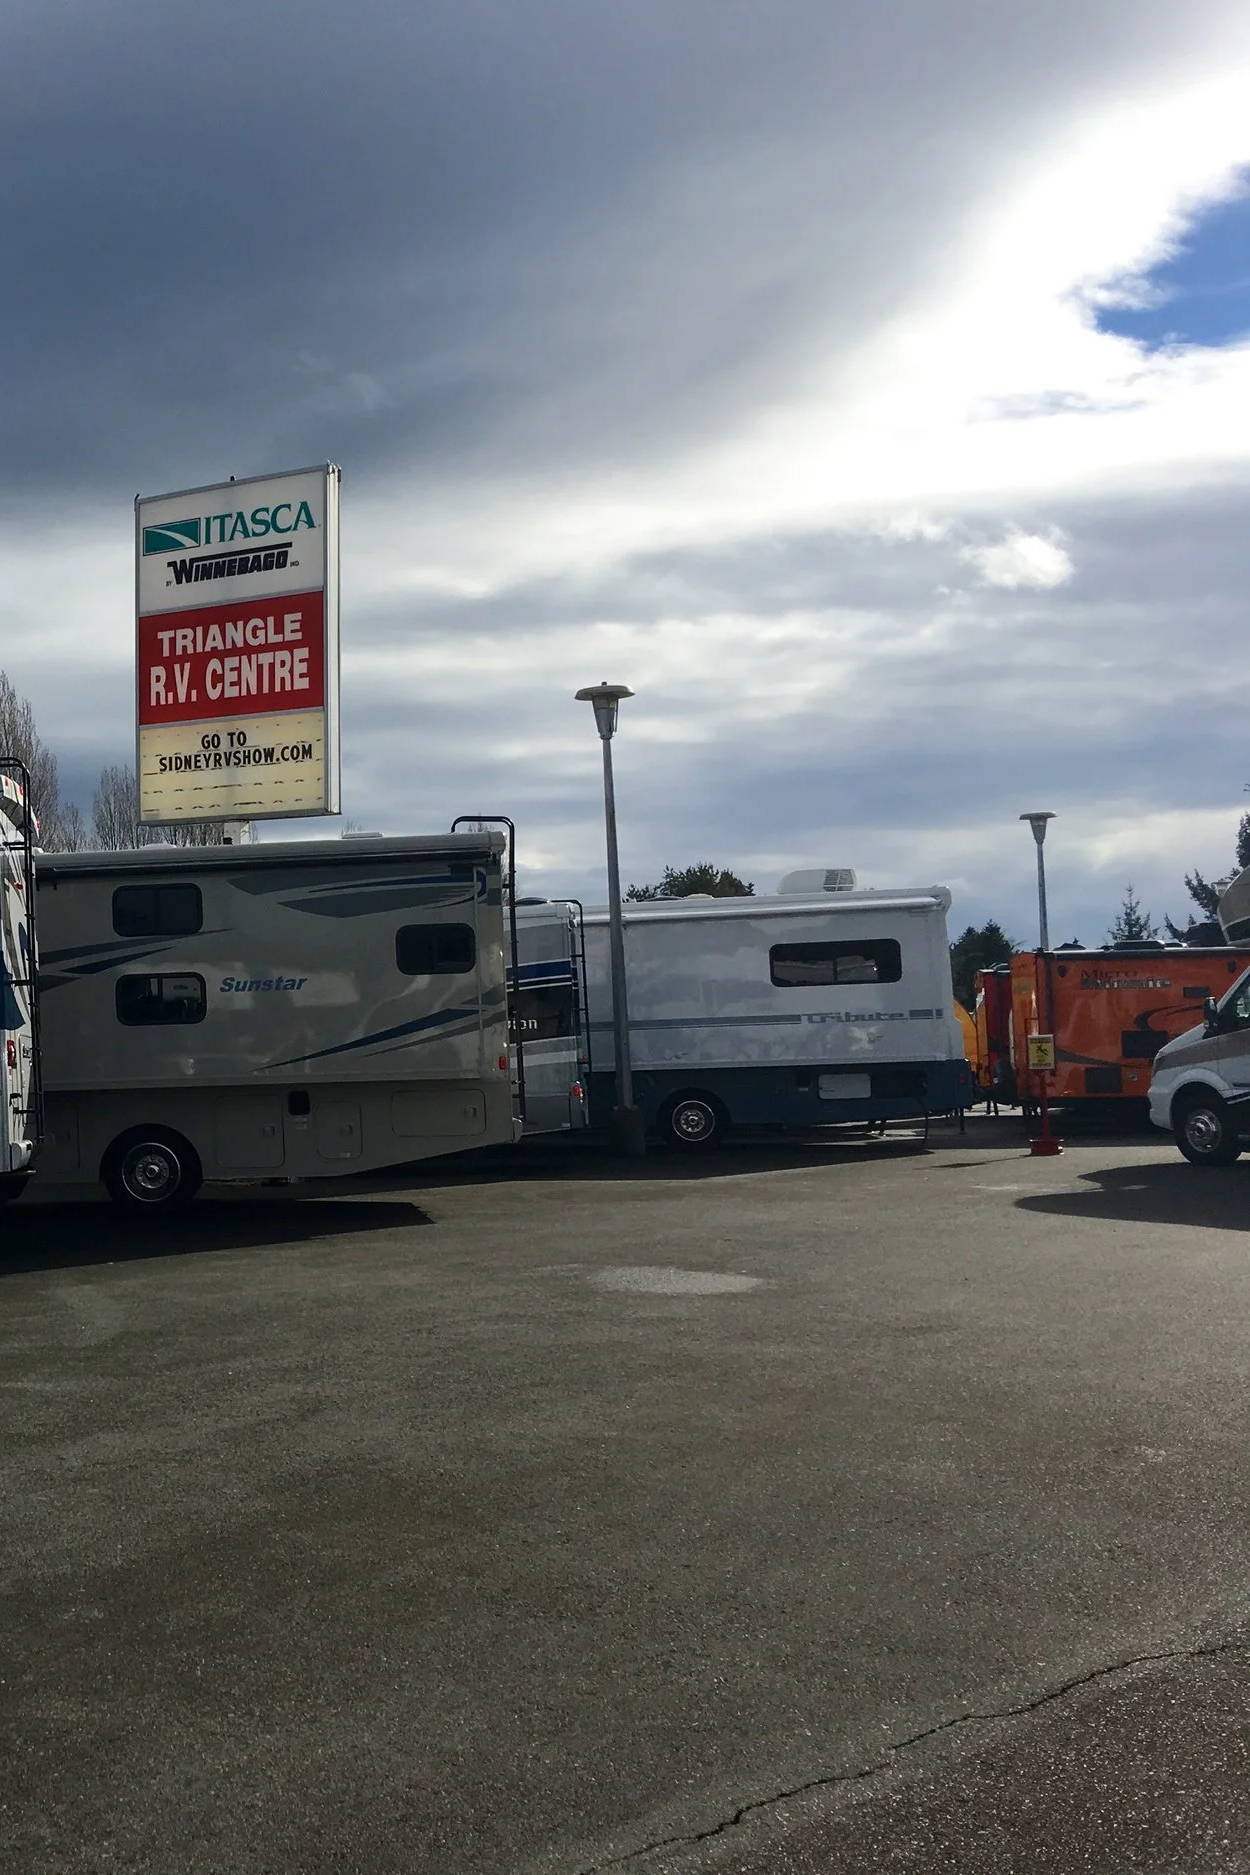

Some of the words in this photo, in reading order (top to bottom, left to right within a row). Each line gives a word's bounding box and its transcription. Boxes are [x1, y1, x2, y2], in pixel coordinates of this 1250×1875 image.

[204, 501, 317, 545] ITASCA
[167, 542, 293, 585] WINNEBAGO
[157, 612, 303, 657] TRIANGLE
[150, 662, 197, 706] R.V.
[205, 647, 310, 700] CENTRE
[159, 743, 313, 772] SIDNEYRVSHOW.COM
[201, 733, 221, 749] GO
[227, 731, 247, 748] TO
[219, 976, 308, 993] Sunstar
[801, 1011, 908, 1024] Tribute
